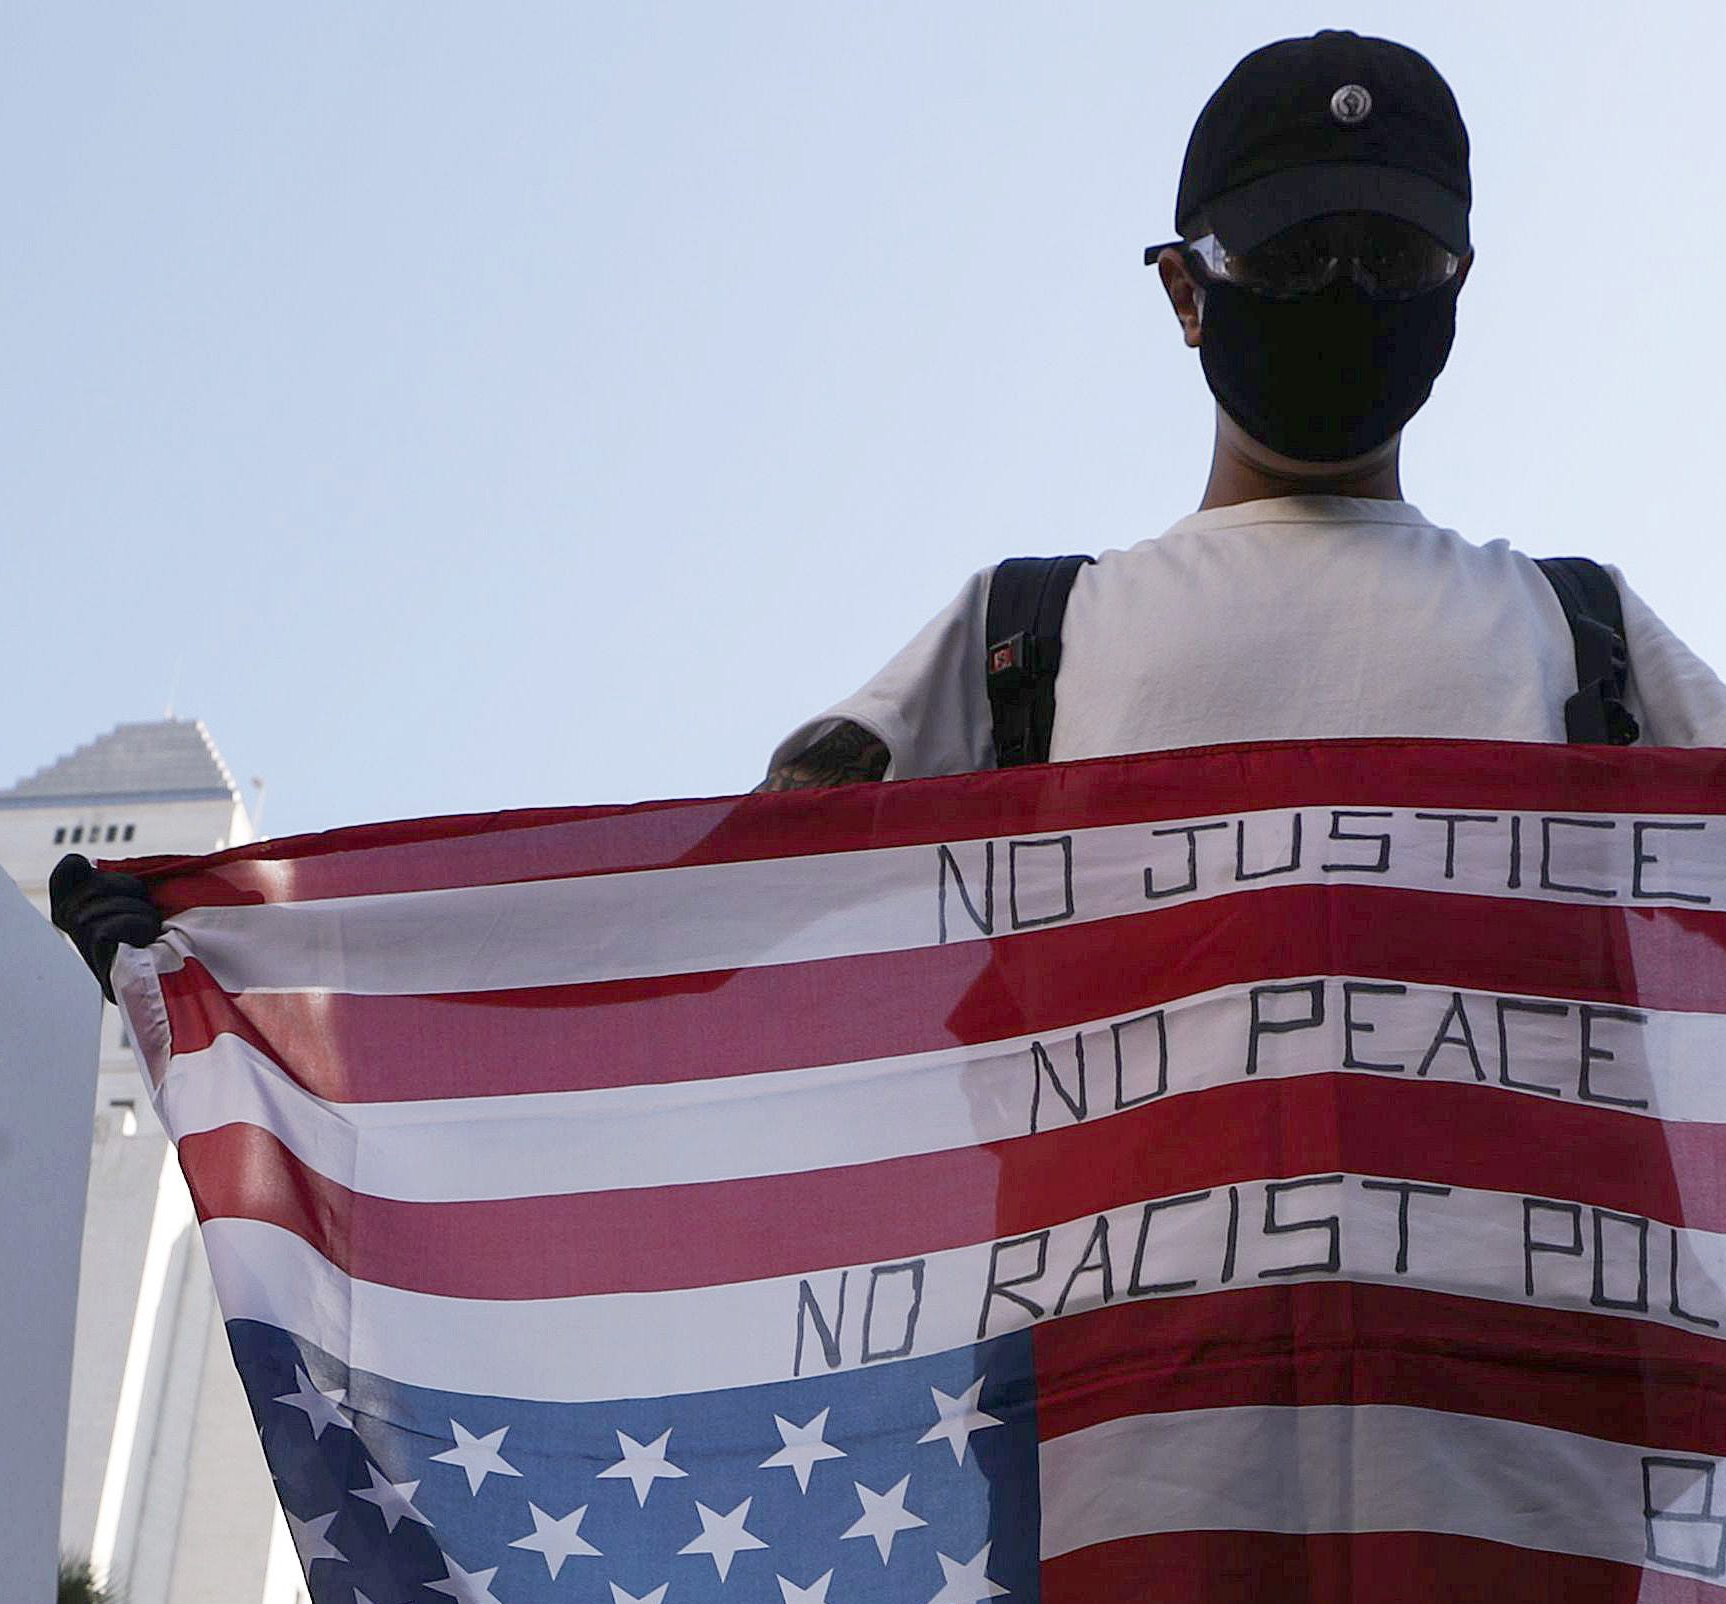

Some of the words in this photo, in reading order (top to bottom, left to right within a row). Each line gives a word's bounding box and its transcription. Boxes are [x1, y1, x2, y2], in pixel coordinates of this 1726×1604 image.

[937, 834, 1074, 944] NO
[1144, 809, 1712, 904] JUSTICE
[1029, 1008, 1168, 1134] NO
[1245, 979, 1650, 1110] PEACE
[791, 1259, 927, 1377] NO
[976, 1174, 1452, 1339] RACIST
